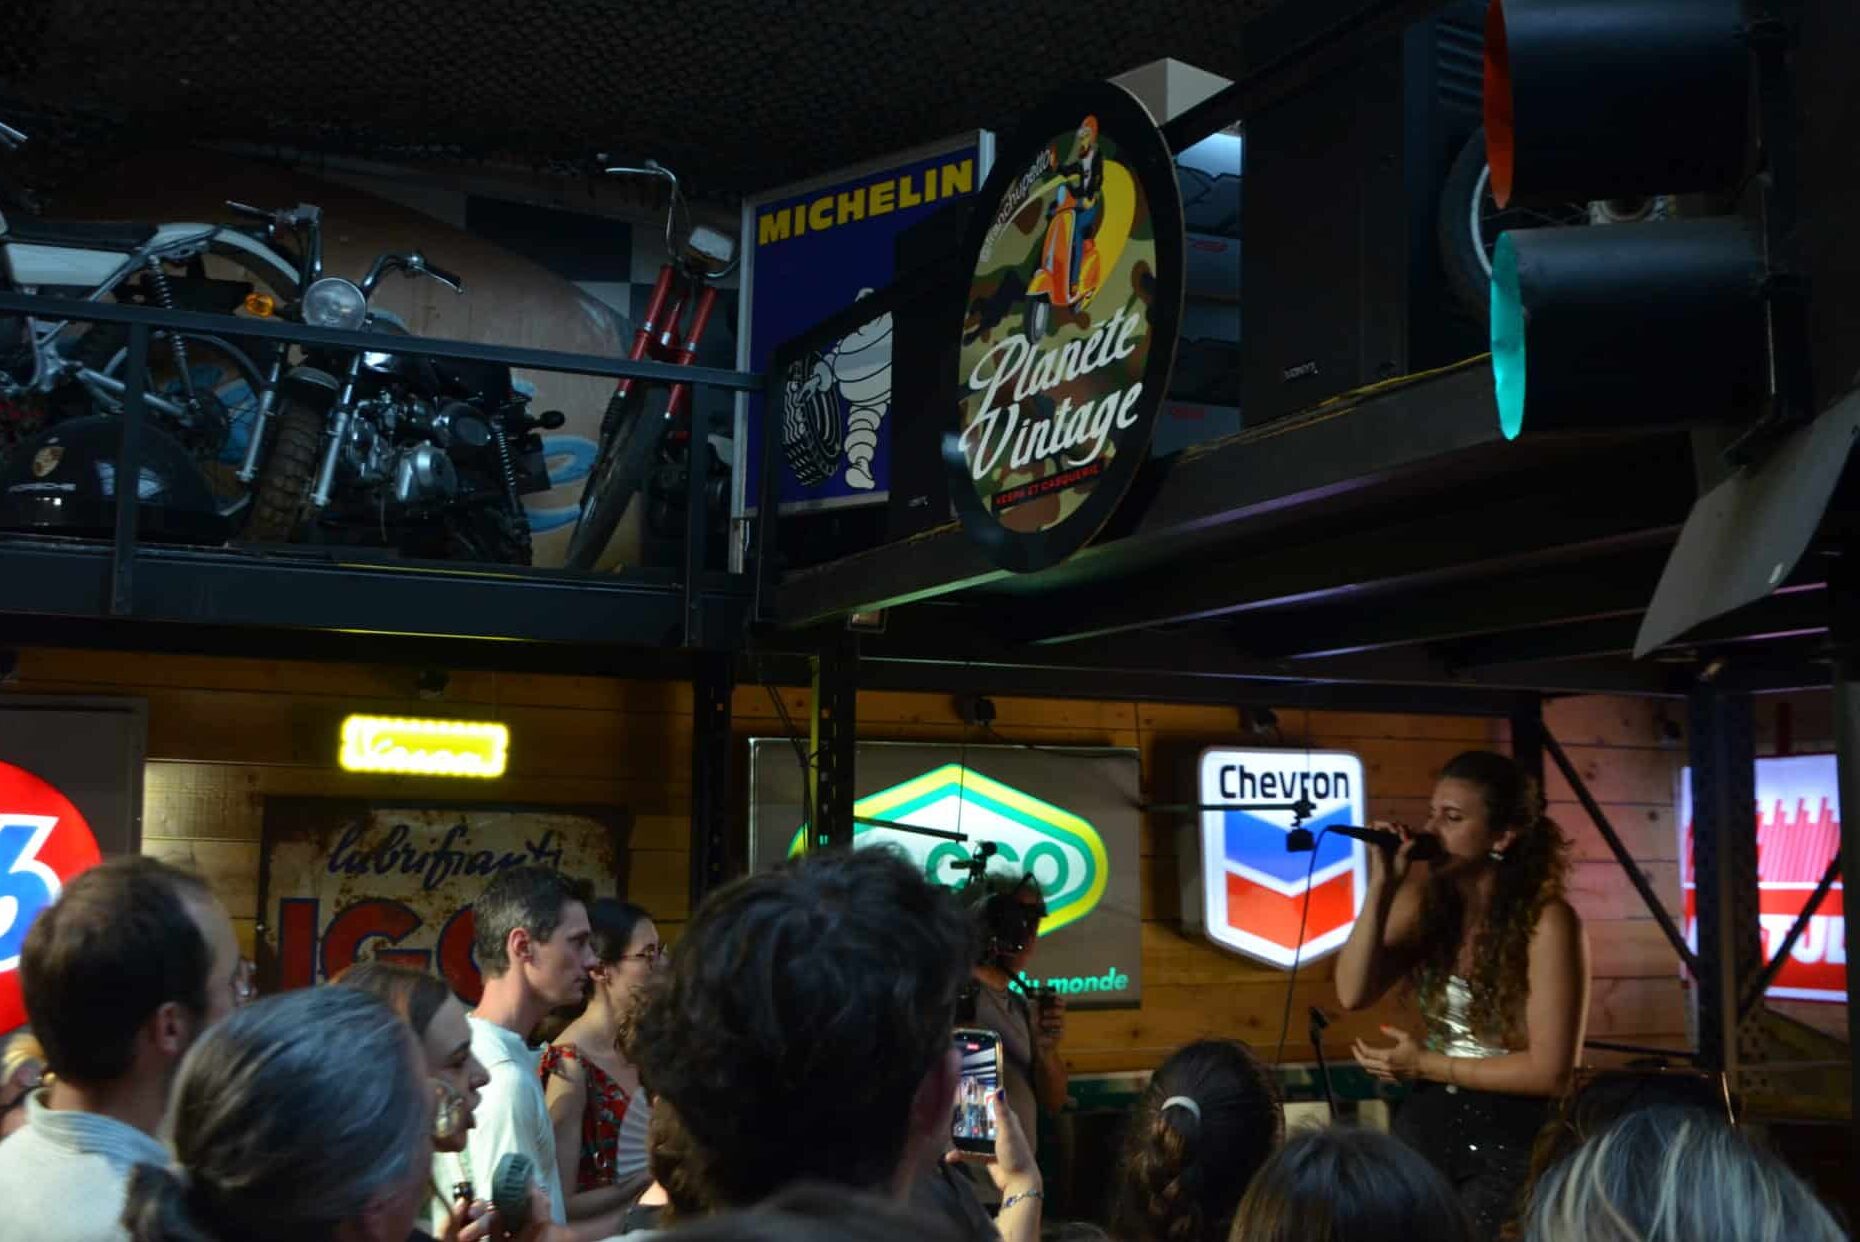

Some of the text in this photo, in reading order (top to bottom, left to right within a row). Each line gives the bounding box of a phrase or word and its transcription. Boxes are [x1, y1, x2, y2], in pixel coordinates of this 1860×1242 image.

[758, 159, 973, 246] MICHELIN
[957, 382, 1143, 481] Vintage
[1219, 764, 1350, 800] Chevron
[1046, 966, 1129, 995] monde
